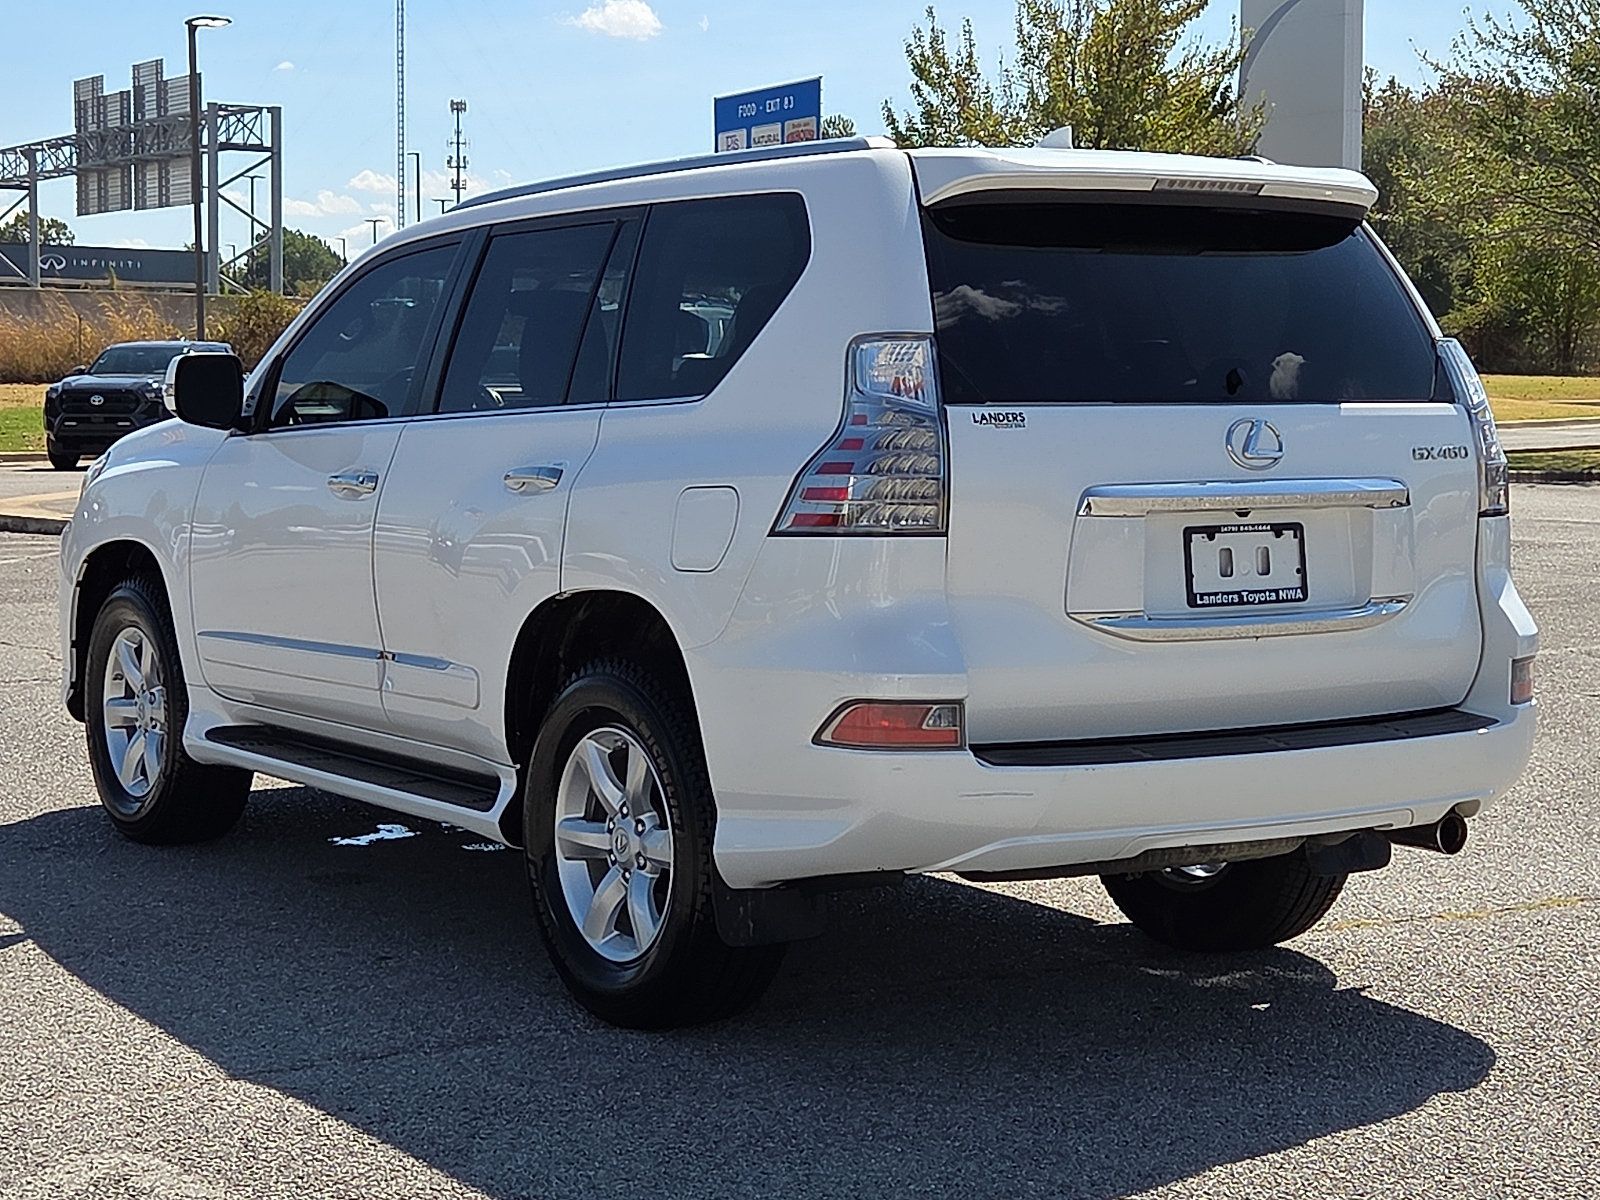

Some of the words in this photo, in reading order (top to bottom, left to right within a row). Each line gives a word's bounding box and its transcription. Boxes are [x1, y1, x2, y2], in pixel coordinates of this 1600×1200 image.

[738, 102, 757, 118] FOOD
[765, 97, 781, 113] EXIT
[72, 258, 142, 269] INFINITI
[971, 411, 1026, 424] LANDERS
[1196, 592, 1239, 605] Landers
[1241, 590, 1276, 604] Toyota
[1278, 588, 1304, 600] NWA
